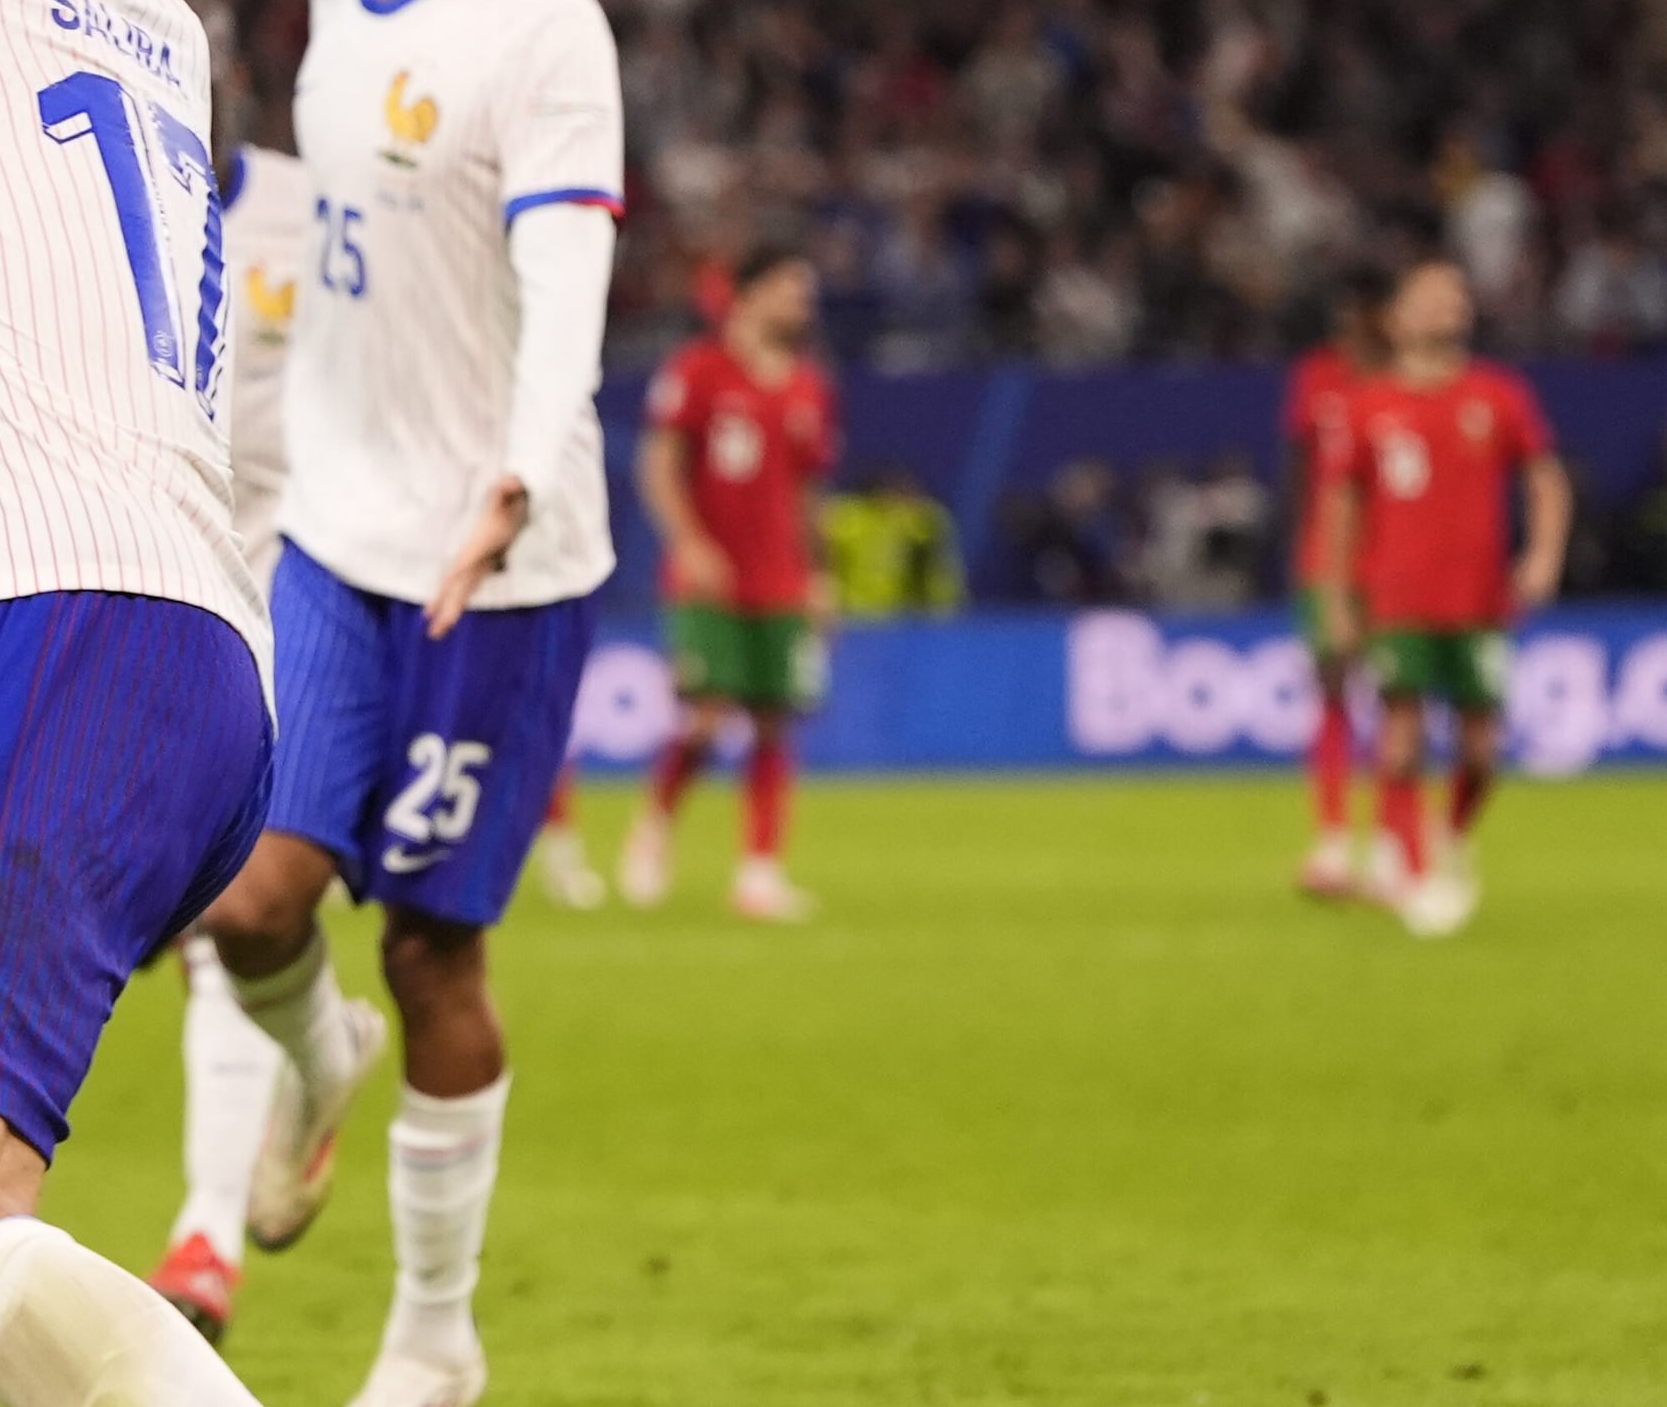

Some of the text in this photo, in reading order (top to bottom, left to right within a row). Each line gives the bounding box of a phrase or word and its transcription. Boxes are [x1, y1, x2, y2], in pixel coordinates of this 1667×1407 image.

[37, 70, 225, 422] 17
[316, 197, 368, 297] 25
[384, 731, 493, 846] 25
